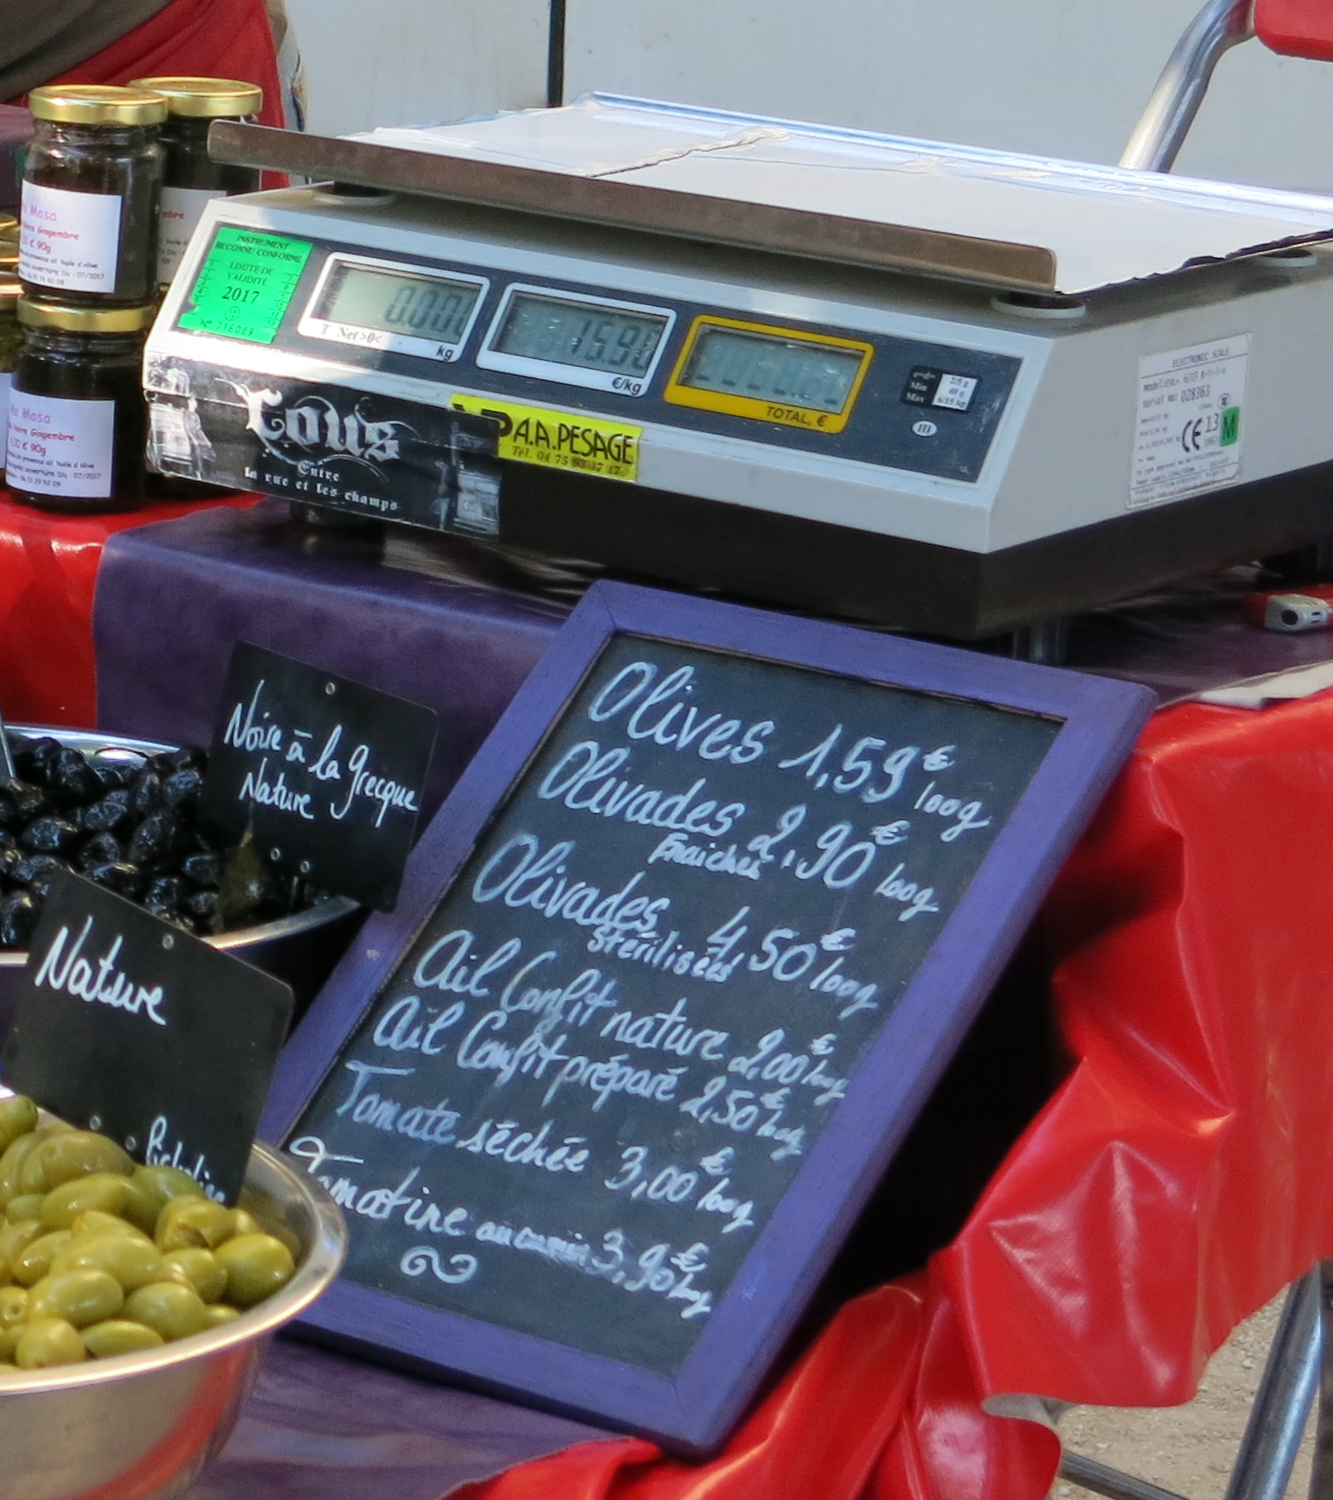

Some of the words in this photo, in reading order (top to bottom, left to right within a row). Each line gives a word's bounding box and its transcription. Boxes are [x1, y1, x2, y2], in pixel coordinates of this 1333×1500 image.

[29, 206, 57, 222] Mosa
[261, 266, 275, 276] DE
[222, 285, 260, 305] 2017
[436, 345, 454, 362] kg
[1211, 347, 1230, 358] SCALE
[612, 376, 642, 396] €/kg
[906, 392, 924, 403] Max
[22, 407, 52, 424] Mosa
[816, 414, 828, 428] €
[30, 427, 75, 443] Gingembre
[30, 442, 47, 457] 90g
[297, 461, 341, 483] Entre
[265, 472, 289, 487] rue
[295, 476, 309, 491] et
[316, 482, 339, 498] les
[344, 488, 399, 511] champs
[587, 660, 776, 765] Olives
[308, 724, 342, 781] la
[239, 757, 315, 820] Nature
[536, 739, 748, 838] Olivades
[471, 833, 671, 935] Olivades
[35, 914, 168, 1027] Nature
[412, 928, 523, 998] Ail
[498, 950, 618, 1034] Confit
[599, 996, 731, 1061] nature
[372, 995, 466, 1056] Ail
[455, 1009, 570, 1088] Confit
[335, 1059, 461, 1146] Tomate
[455, 1119, 591, 1174] séchée
